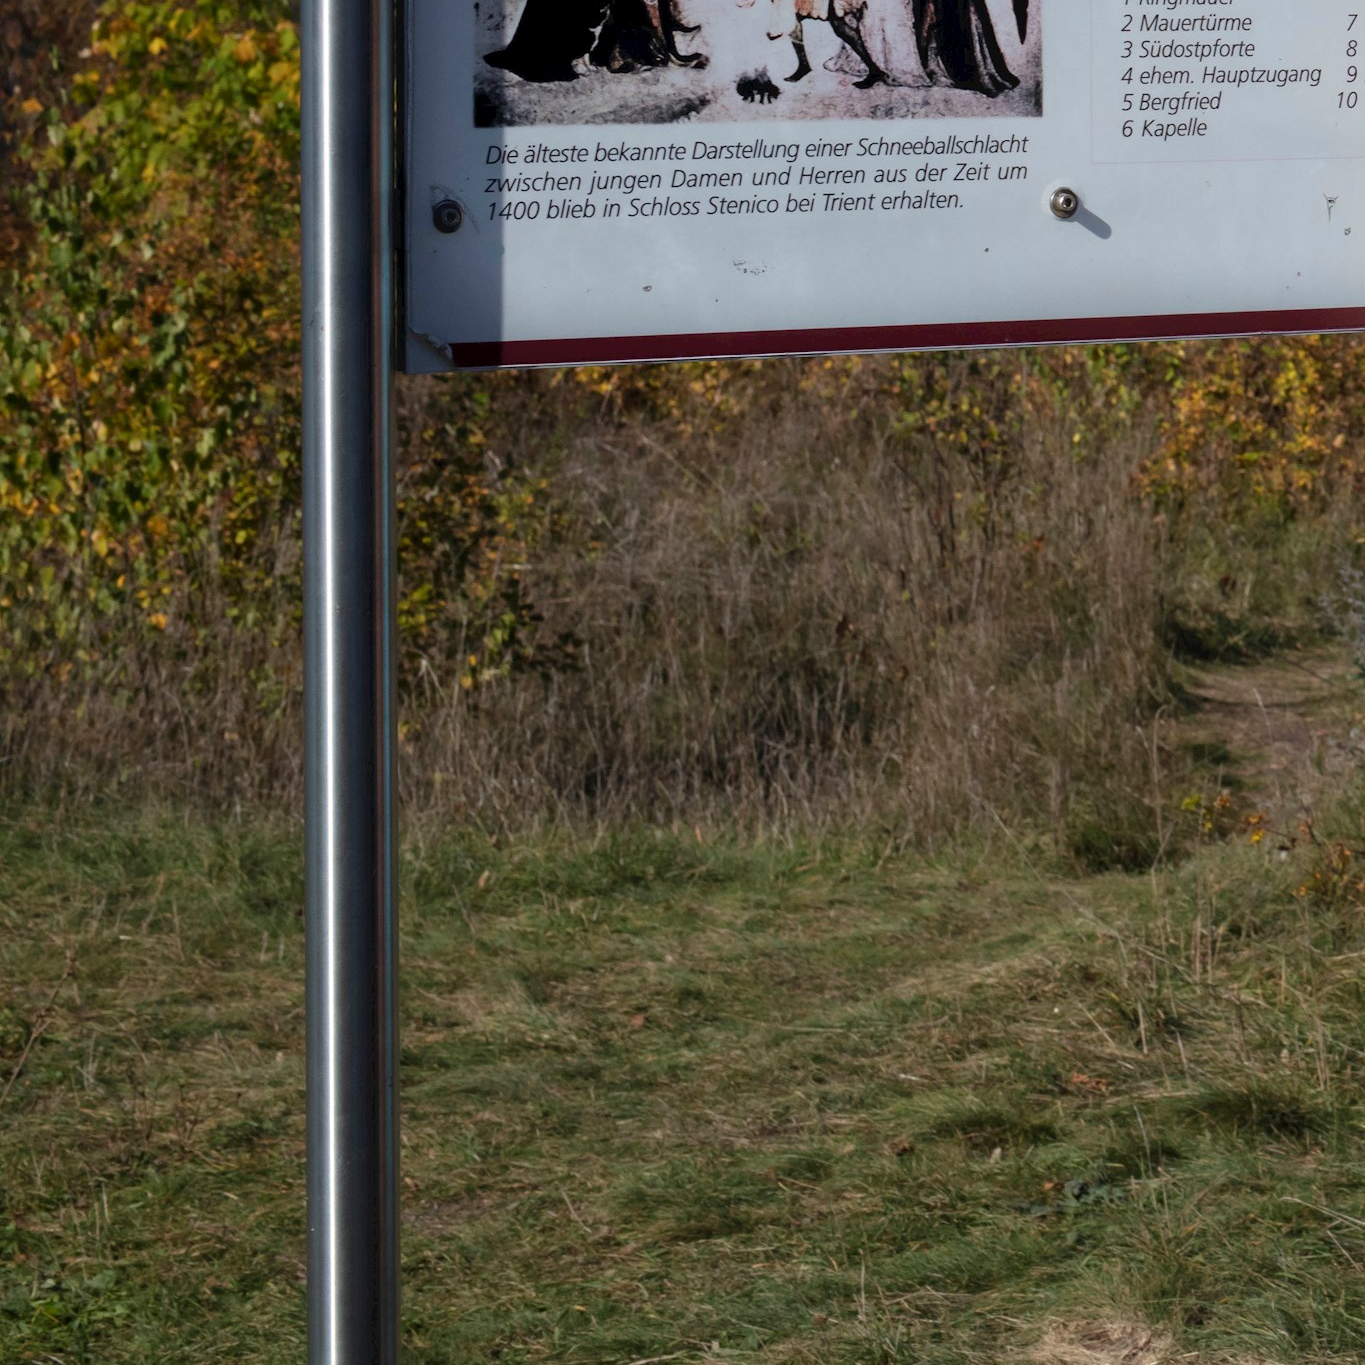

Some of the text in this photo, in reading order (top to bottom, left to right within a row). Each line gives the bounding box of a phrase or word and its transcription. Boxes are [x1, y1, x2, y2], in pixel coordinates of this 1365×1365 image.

[1120, 13, 1252, 32] 2 Mauertürme
[1347, 14, 1358, 31] 7
[1120, 38, 1255, 62] 3 Südostpforte
[1346, 39, 1358, 57] 8
[1120, 65, 1322, 87] 4 ehem. Hauptzugang
[1346, 65, 1358, 83] 9
[1121, 90, 1222, 115] 5 Bergfried
[1337, 91, 1358, 108] 10
[1122, 117, 1207, 141] 6 Kapelle
[485, 134, 1029, 166] Die älteste bekannte Darstellung einer Schneeballschlacht
[483, 161, 1028, 195] zwischen jungen Damen und Herren aus der Zeit um
[488, 189, 963, 221] 1400 blieb in Schloss Stenico bei Trient erhalten.
